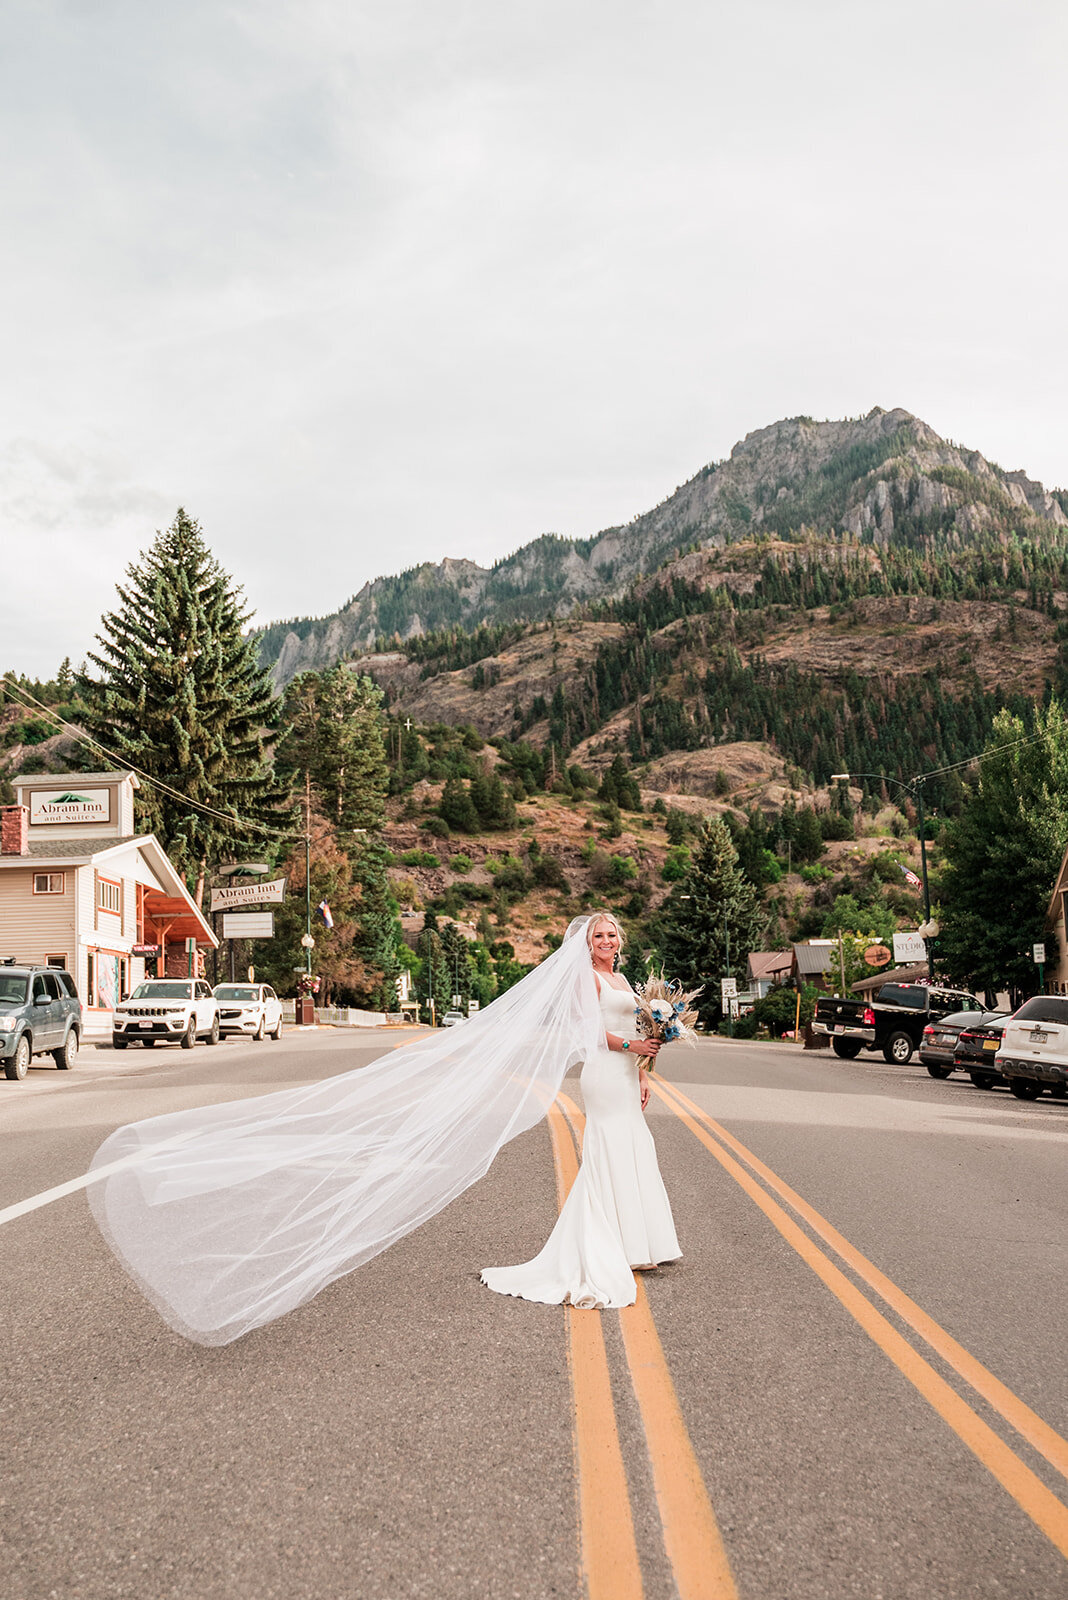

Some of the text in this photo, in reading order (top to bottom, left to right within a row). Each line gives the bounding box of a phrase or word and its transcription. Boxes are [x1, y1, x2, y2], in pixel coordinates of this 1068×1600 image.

[38, 803, 102, 814] Abram Inn
[216, 884, 276, 899] Abram Inn
[896, 942, 925, 950] STUDIO
